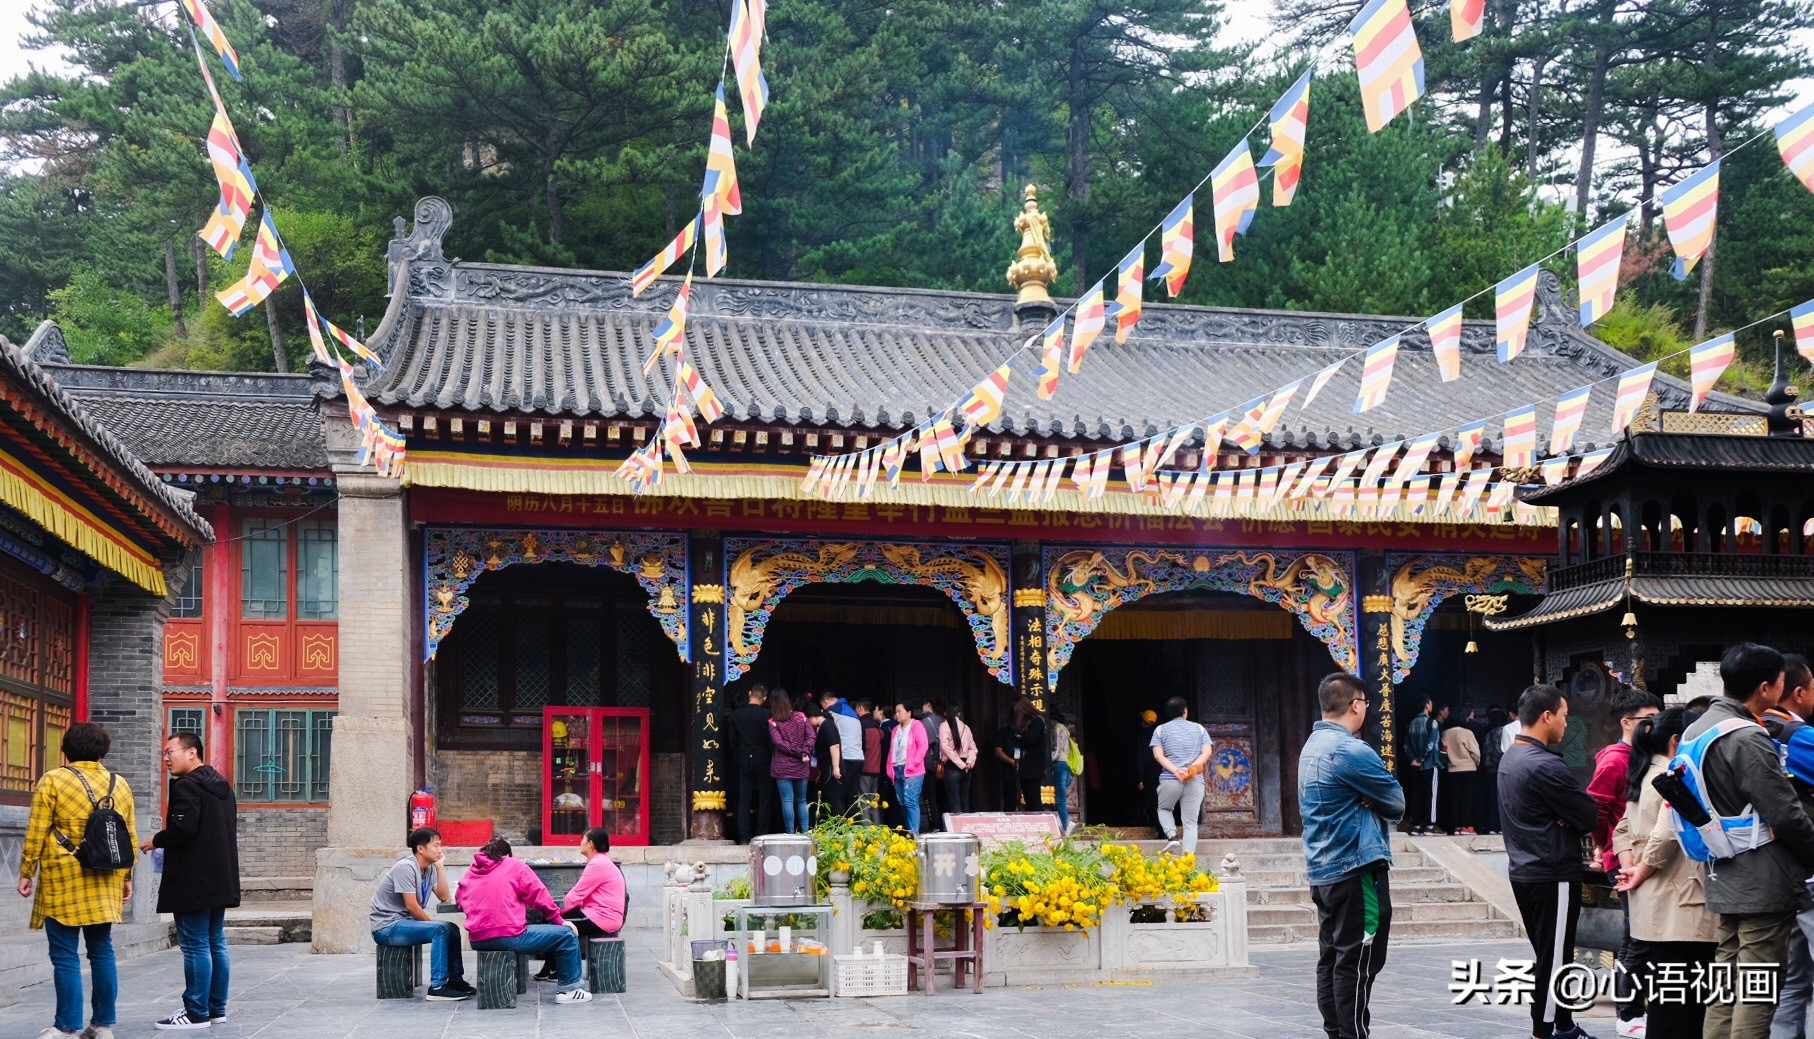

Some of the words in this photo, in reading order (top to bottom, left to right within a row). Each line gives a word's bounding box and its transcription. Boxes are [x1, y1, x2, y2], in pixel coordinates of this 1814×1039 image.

[507, 495, 625, 514] 阴历八月十五日
